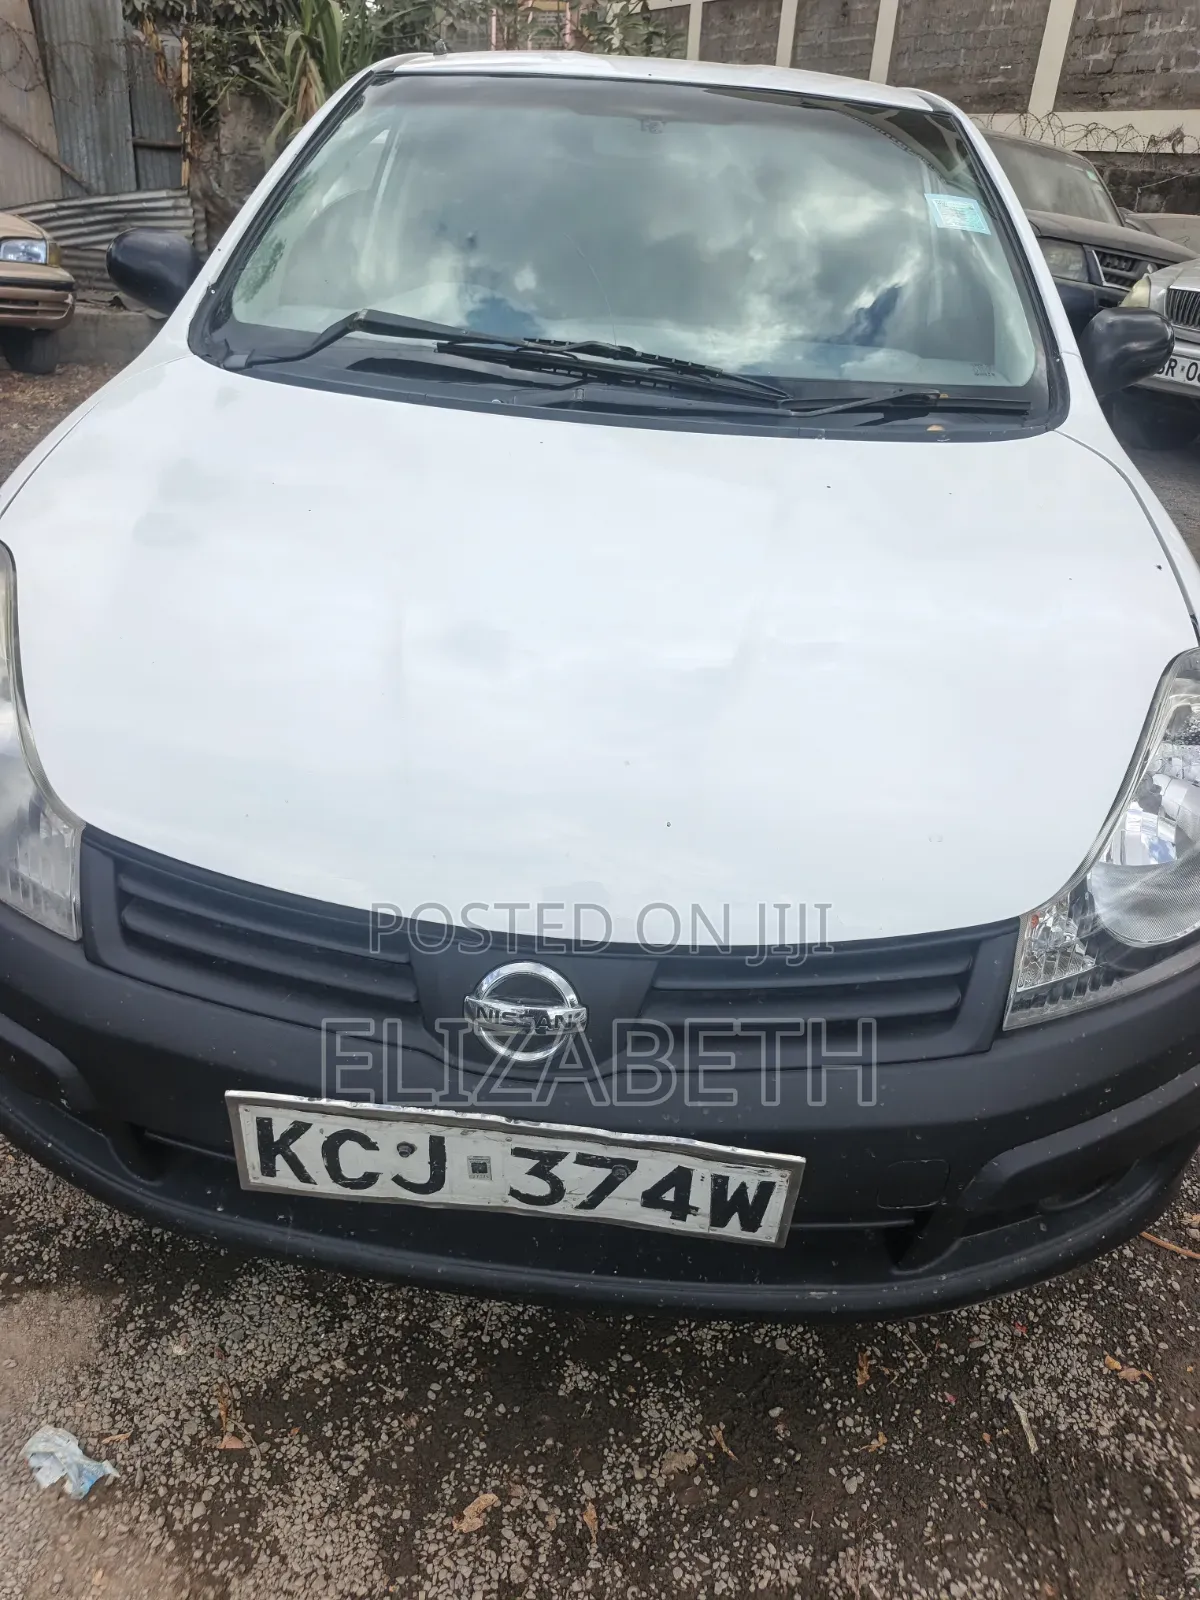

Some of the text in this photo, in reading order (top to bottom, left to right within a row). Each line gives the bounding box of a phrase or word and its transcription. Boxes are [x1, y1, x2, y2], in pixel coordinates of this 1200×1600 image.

[476, 1005, 574, 1031] NISSAN
[255, 1116, 776, 1233] KCJ 374W
